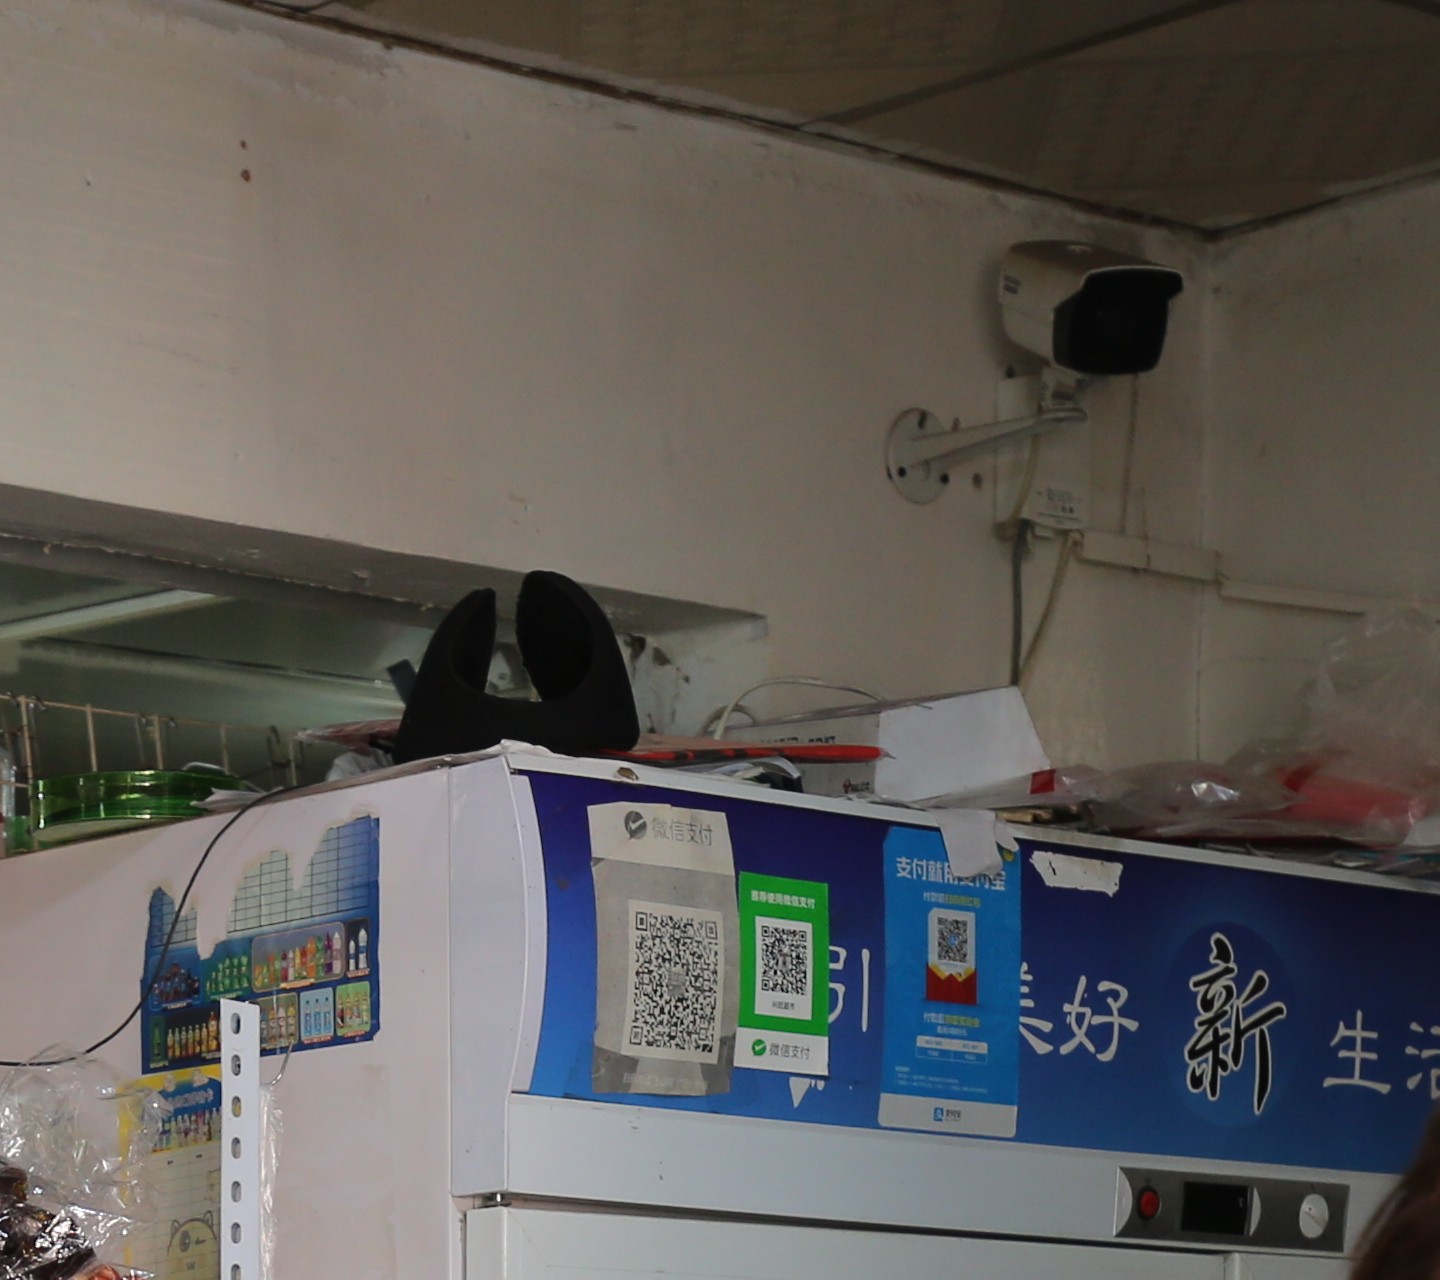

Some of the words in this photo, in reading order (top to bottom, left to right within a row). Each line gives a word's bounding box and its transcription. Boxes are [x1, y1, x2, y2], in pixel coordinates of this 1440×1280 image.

[652, 817, 713, 846] 微信支付
[1184, 932, 1287, 1115] 新
[769, 1043, 811, 1060] 微信支付
